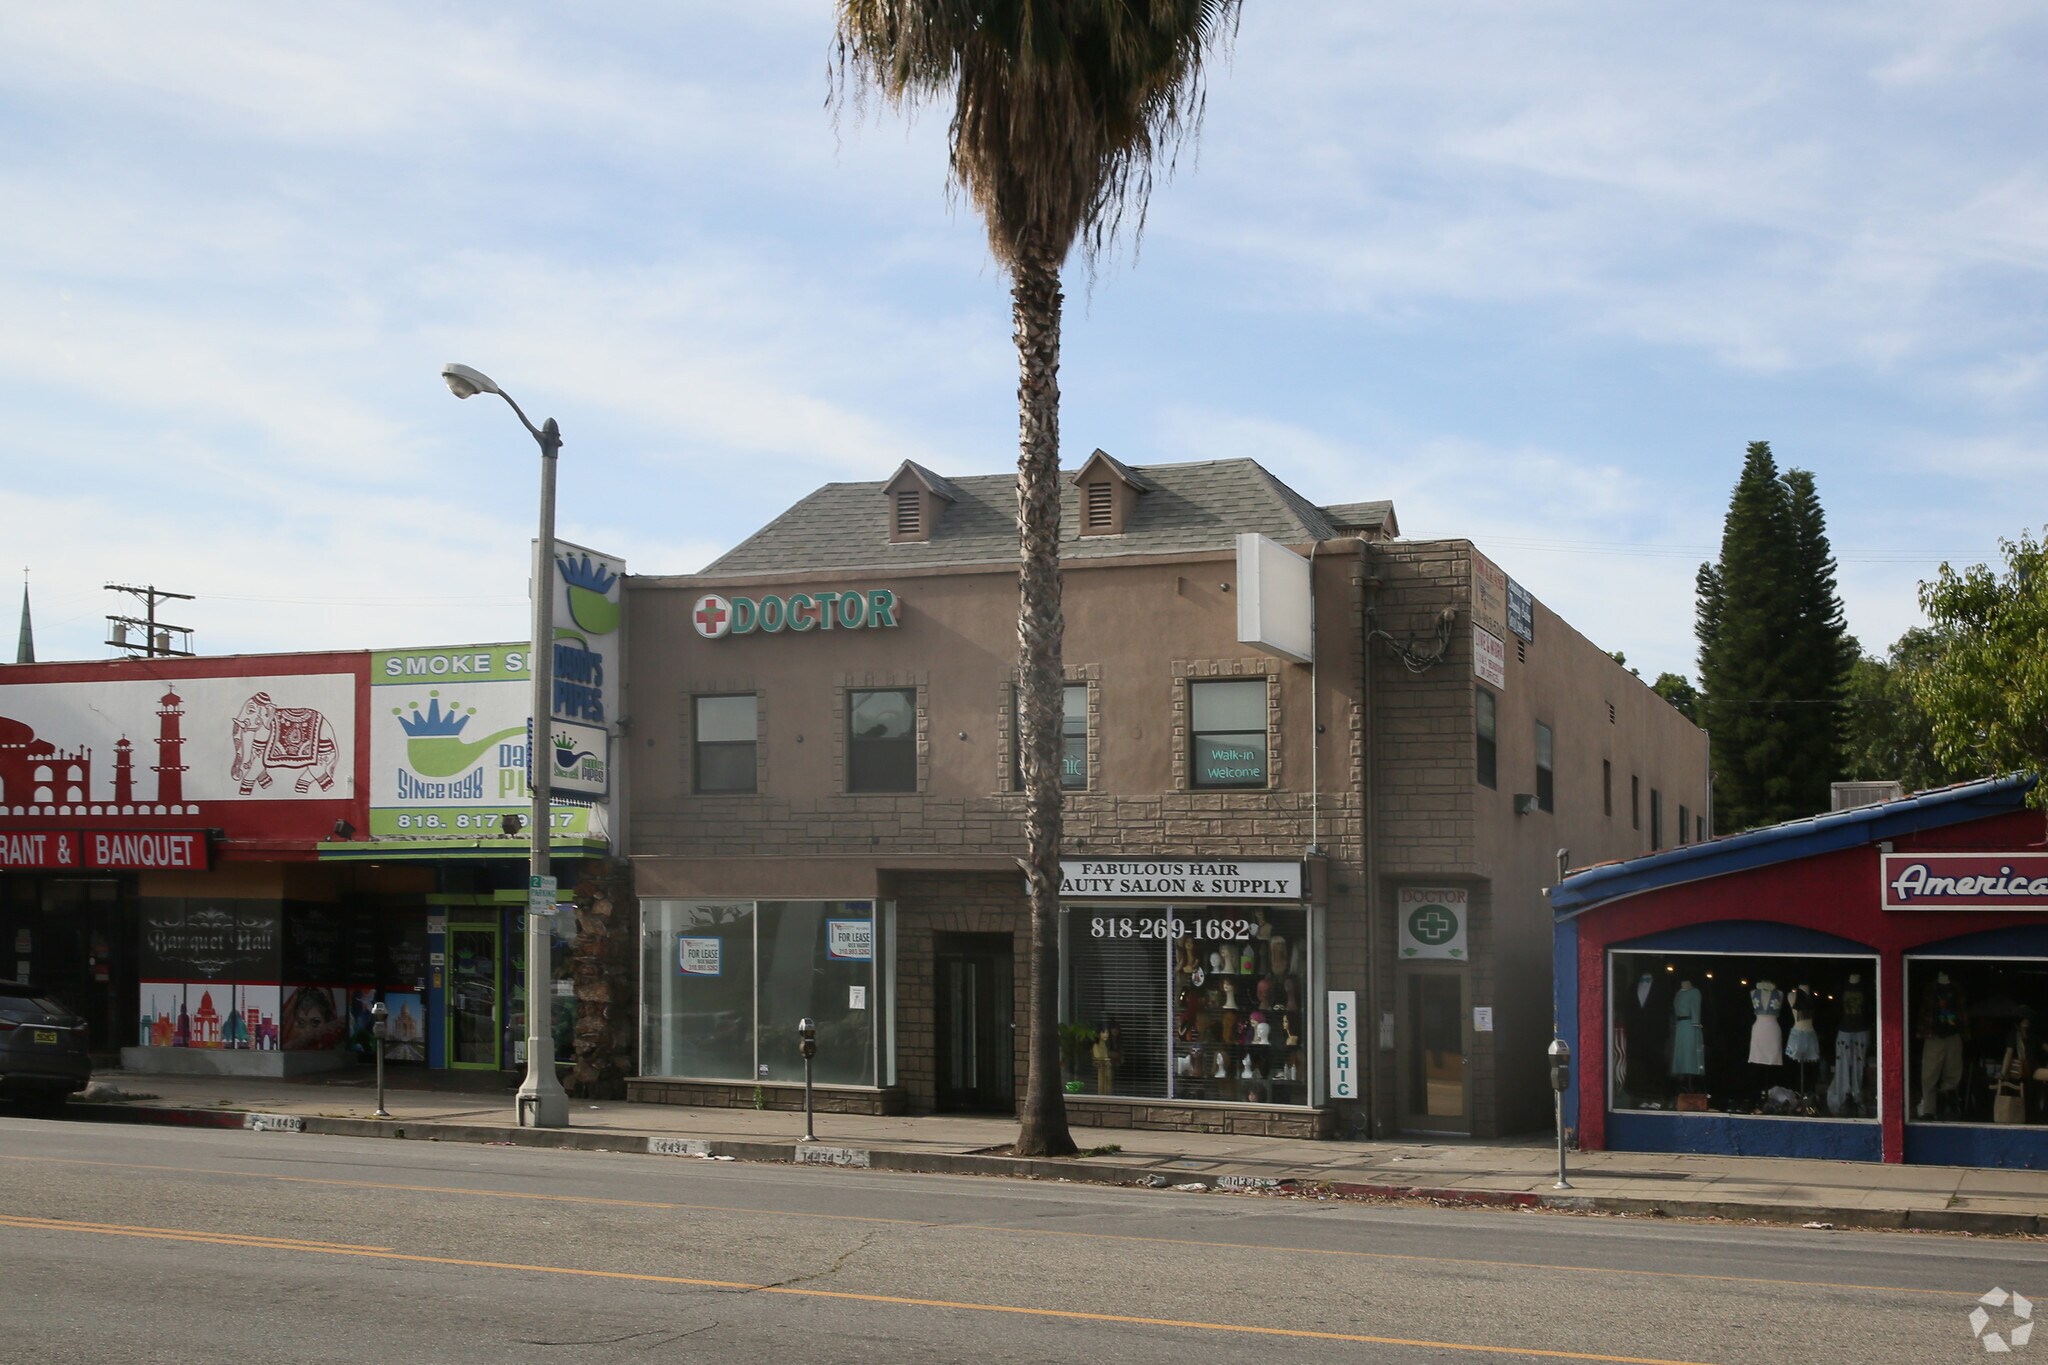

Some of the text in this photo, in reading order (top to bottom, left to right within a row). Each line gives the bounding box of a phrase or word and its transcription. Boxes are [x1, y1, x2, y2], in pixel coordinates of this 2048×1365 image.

[731, 588, 898, 634] DOCTOR
[385, 652, 531, 676] SMOKE S
[554, 679, 605, 723] PIPES
[499, 743, 529, 767] Da
[1211, 749, 1255, 761] Walk-in
[449, 766, 484, 799] 1998
[499, 768, 533, 798] PI
[1207, 766, 1260, 779] Welcome
[0, 834, 194, 867] RANT & BANQUET
[1081, 863, 1240, 876] FABULOUS HAIR
[532, 877, 539, 888] 2
[1120, 879, 1187, 893] SALON
[1191, 879, 1206, 893] &
[1211, 879, 1290, 894] SUPPLY
[1401, 889, 1467, 904] DOCTOR
[838, 932, 871, 943] FOR LEASE
[1090, 917, 1250, 940] 818-269-1682
[688, 948, 719, 959] FOR LEASE
[1336, 1002, 1350, 1096] PSYCHIC
